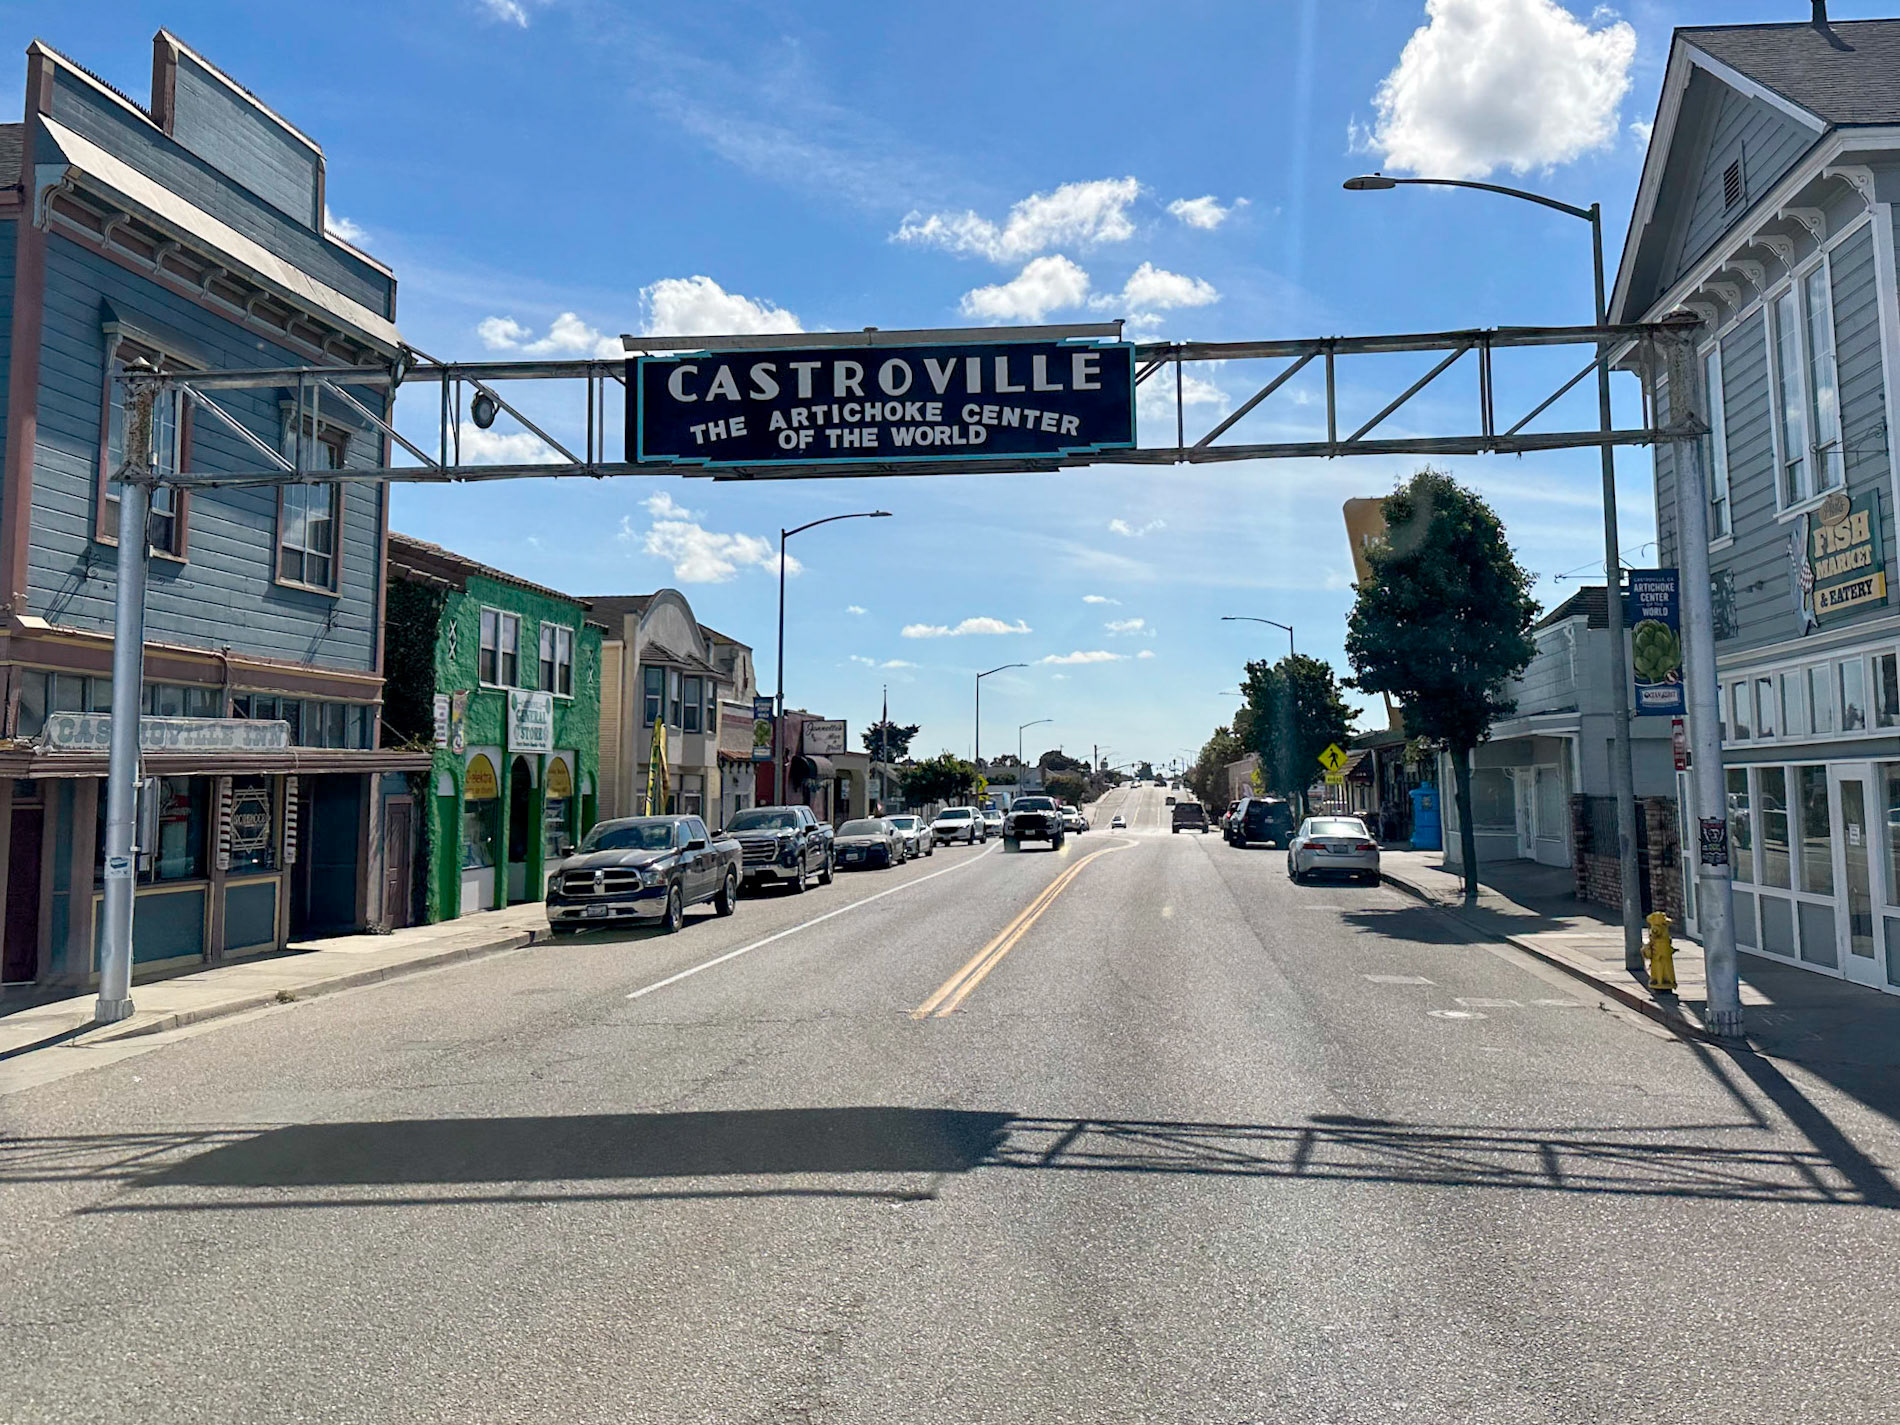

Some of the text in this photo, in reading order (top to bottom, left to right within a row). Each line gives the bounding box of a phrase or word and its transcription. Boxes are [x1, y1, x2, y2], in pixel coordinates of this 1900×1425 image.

[668, 353, 1101, 402] CASTROVILLE
[690, 402, 1080, 445] THE ARTICHOKE CENTER
[778, 425, 987, 449] OF THE WORLD
[1813, 510, 1871, 559] FISH
[1815, 544, 1872, 581] MARKET
[1634, 583, 1675, 592] ARTICHOKE
[1640, 593, 1669, 602] CENTER
[1820, 579, 1873, 608] & EATERY
[1642, 607, 1669, 617] WORLD
[516, 709, 547, 724] GENERAL
[58, 718, 234, 746] CASOVILLE
[520, 726, 543, 741] STORE
